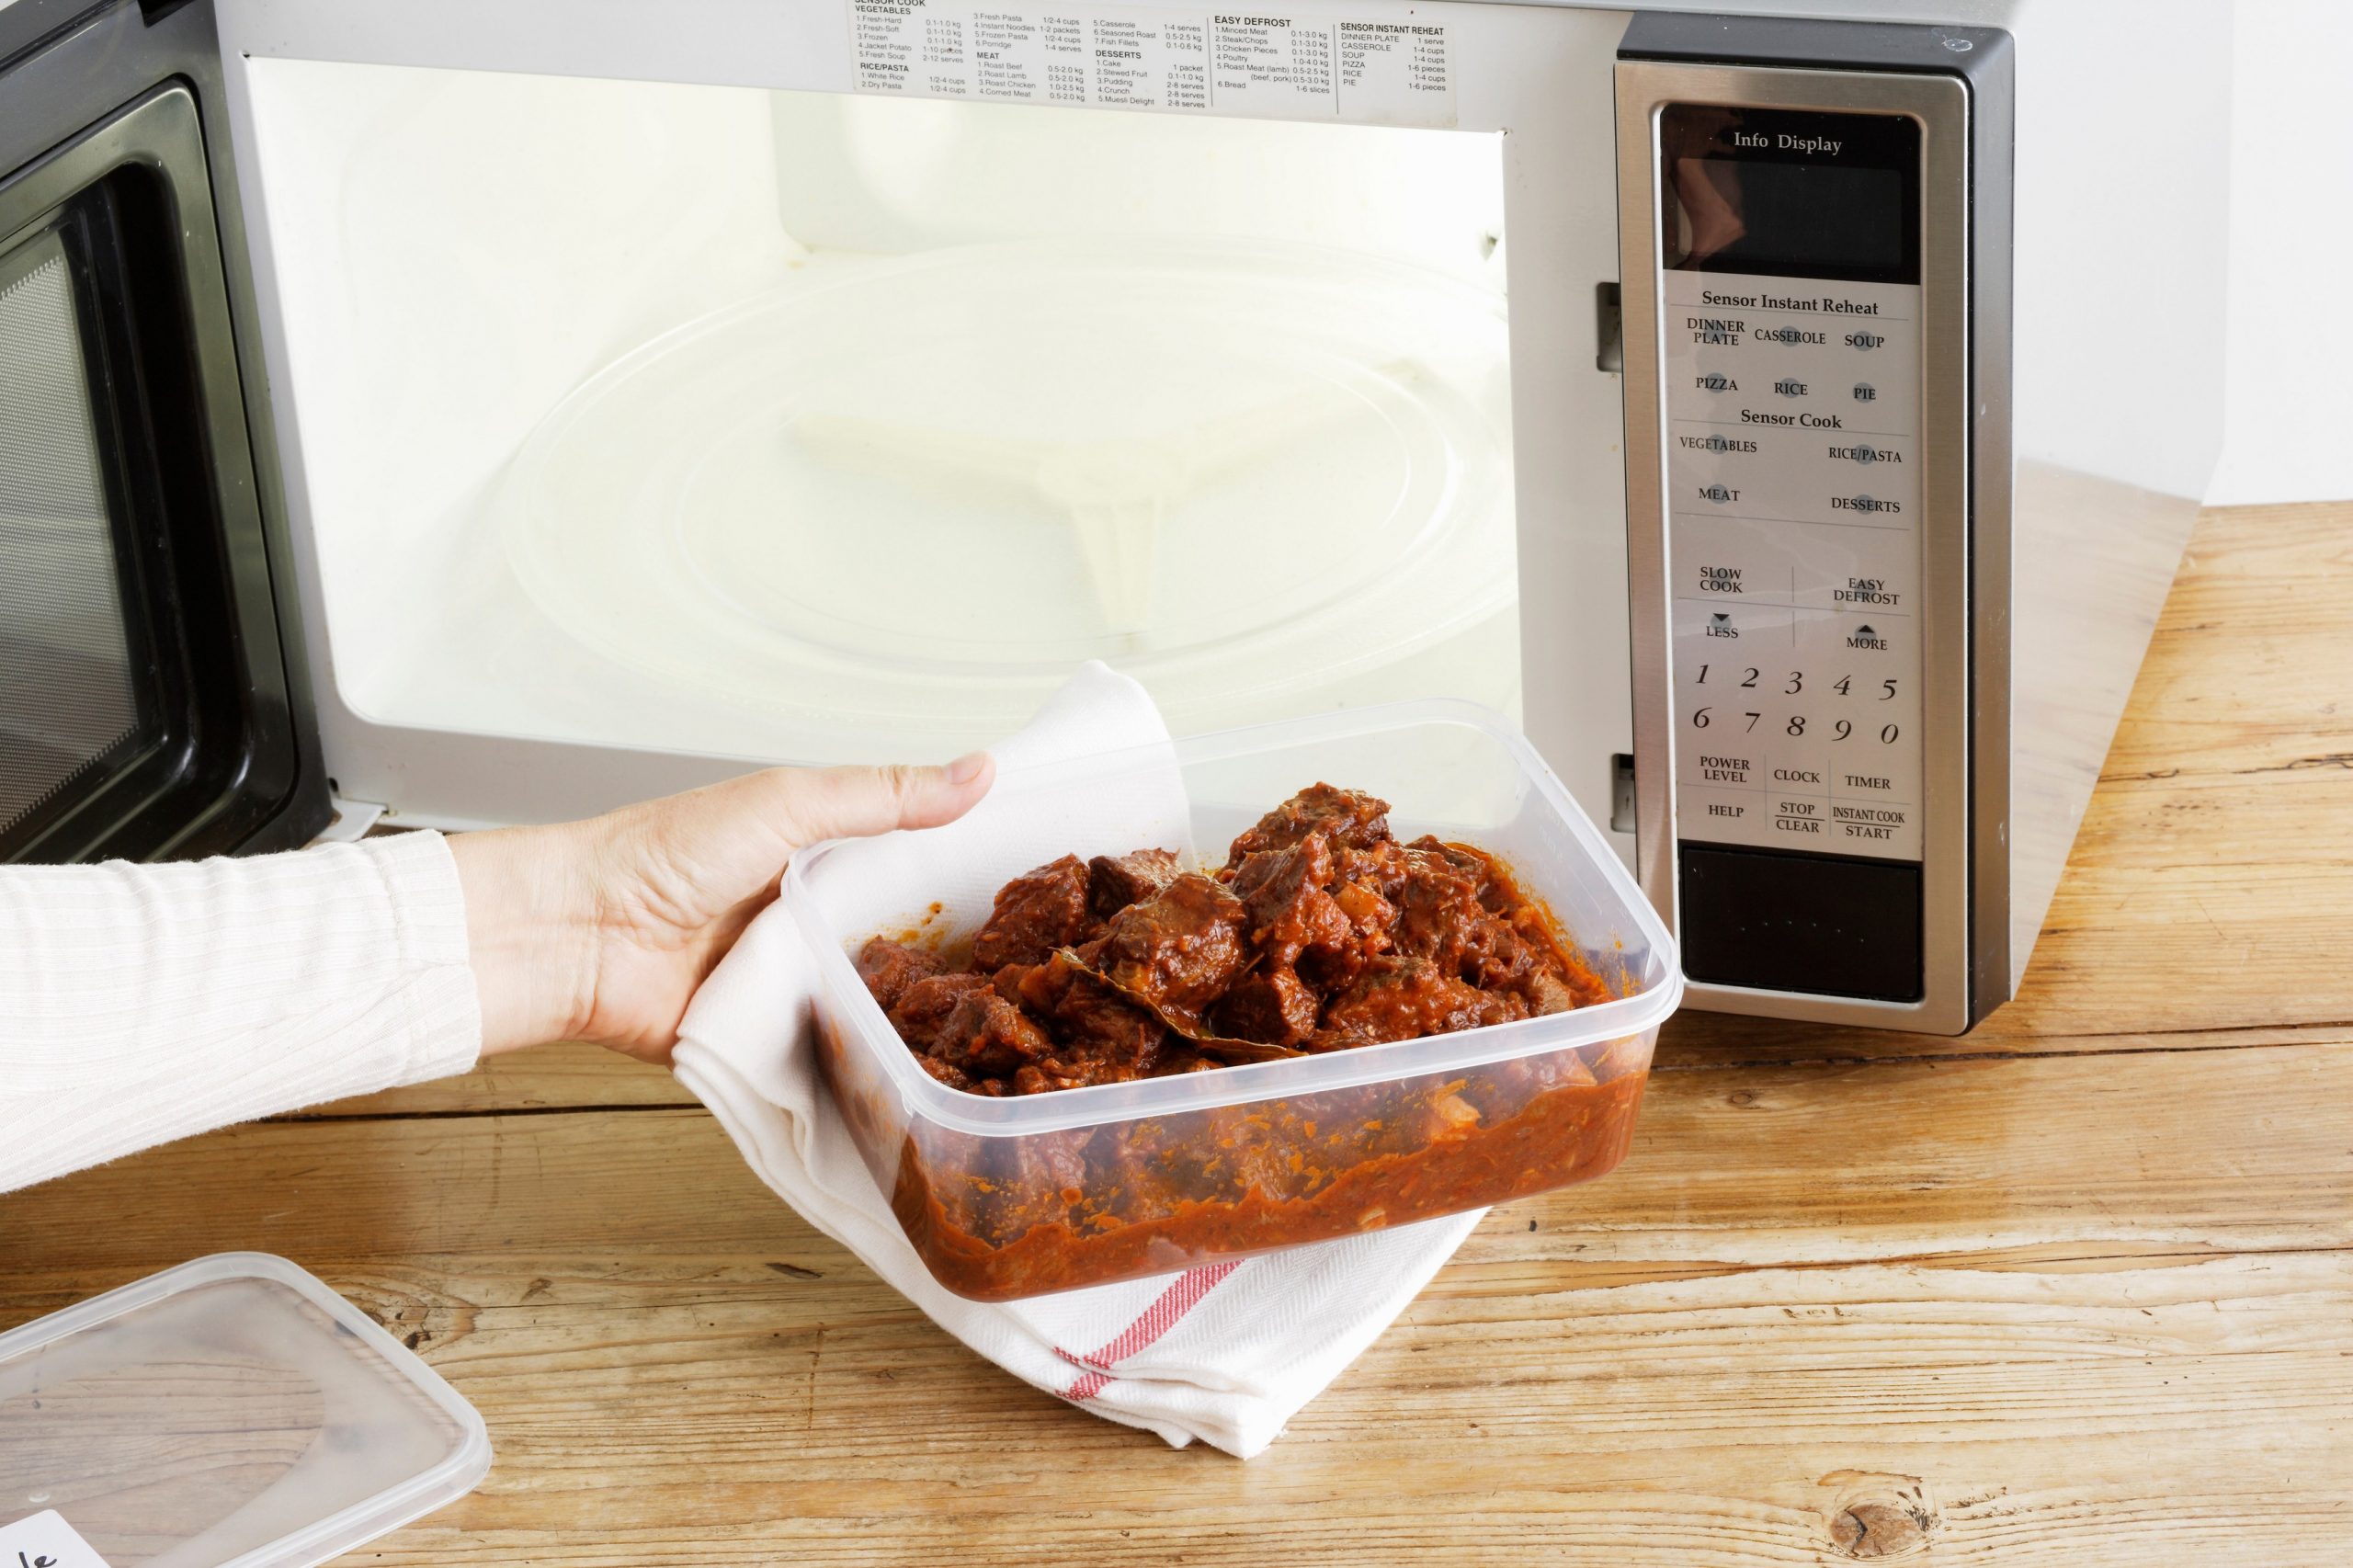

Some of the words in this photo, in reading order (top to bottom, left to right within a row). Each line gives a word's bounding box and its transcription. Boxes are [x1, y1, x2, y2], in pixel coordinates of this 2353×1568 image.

[855, 5, 911, 15] VEGETABLES
[1002, 14, 1023, 22] Pasta
[1214, 15, 1242, 25] EASY
[1244, 17, 1291, 28] DEFROST
[1007, 32, 1029, 40] Pasta
[1040, 25, 1051, 33] 1-2
[1052, 26, 1081, 35] packets
[1135, 30, 1156, 40] Roast
[1192, 34, 1202, 42] kg
[1249, 28, 1268, 36] Meat
[1318, 32, 1327, 40] kg
[1340, 22, 1374, 32] SENSOR
[1375, 24, 1410, 34] INSTANT
[1411, 26, 1444, 36] REHEAT
[1340, 32, 1372, 41] DINNER
[1374, 34, 1400, 43] PLATE
[889, 43, 912, 51] Potato
[1118, 39, 1140, 47] Fillets
[1193, 44, 1202, 52] kg
[1254, 46, 1279, 55] Pieces
[1318, 41, 1328, 50] kg
[1341, 41, 1392, 51] CASSEROLE
[887, 51, 905, 61] Soup
[922, 54, 938, 62] 2-12
[976, 51, 1000, 60] MEAT
[1095, 49, 1142, 60] DESSERTS
[1341, 51, 1365, 59] SOUP
[859, 62, 910, 72] RICE/PASTA
[1179, 64, 1203, 73] packet
[1319, 60, 1329, 68] kg
[1342, 60, 1366, 69] PIZZA
[1421, 65, 1446, 74] pieces
[889, 73, 905, 81] Rice
[1131, 70, 1148, 78] Fruit
[1195, 74, 1204, 83] kg
[1320, 69, 1329, 77] kg
[1342, 69, 1362, 78] RICE
[881, 82, 903, 90] Pasta
[949, 86, 966, 95] cups
[1006, 80, 1037, 89] Chicken
[1166, 81, 1179, 89] 2-8
[1320, 78, 1330, 86] kg
[1343, 78, 1357, 86] PIE
[1422, 84, 1447, 92] pieces
[1013, 89, 1032, 97] Meat
[1129, 97, 1154, 107] Delight
[1733, 131, 1769, 149] Info
[1778, 133, 1843, 156] Display
[1701, 290, 1757, 310] Sensor
[1760, 293, 1819, 312] Instant
[1823, 297, 1879, 315] Reheat
[1687, 317, 1745, 334] DINNER
[1693, 331, 1740, 347] PLATE
[1754, 328, 1826, 346] CASSEROLE
[1844, 335, 1885, 349] SOUP
[1696, 377, 1739, 392] PIZZA
[1773, 382, 1809, 397] RICE
[1853, 387, 1877, 401] PIE
[1740, 408, 1796, 427] Sensor
[1799, 412, 1843, 430] Cook
[1679, 437, 1758, 453] VEGETABLES
[1828, 447, 1903, 464] RICE/PASTA
[1698, 487, 1741, 502] MEAT
[1831, 496, 1902, 514] DESSERTS
[1699, 566, 1742, 581] SLOW
[1699, 579, 1744, 595] COOK
[1847, 577, 1885, 592] EASY
[1833, 589, 1901, 607] DEFROST
[1706, 625, 1739, 640] LESS
[1846, 636, 1888, 652] MORE
[1695, 664, 1711, 685] 1
[1740, 667, 1759, 688] 2
[1784, 670, 1803, 695] 3
[1833, 674, 1852, 696] 4
[1879, 678, 1898, 700] 5
[1693, 707, 1713, 729] 6
[1745, 712, 1761, 733] 7
[1786, 715, 1806, 737] 8
[1831, 719, 1852, 742] 9
[1881, 723, 1900, 744] 0
[1699, 756, 1751, 771] POWER
[1703, 769, 1747, 784] LEVEL
[1773, 768, 1821, 784] CLOCK
[1844, 775, 1892, 790] TIMER
[1708, 804, 1745, 818] HELP
[1779, 801, 1815, 816] STOP
[1832, 806, 1876, 822] INSTANT
[1877, 810, 1905, 824] COOK
[1775, 819, 1820, 834] CLEAR
[1845, 825, 1893, 841] START
